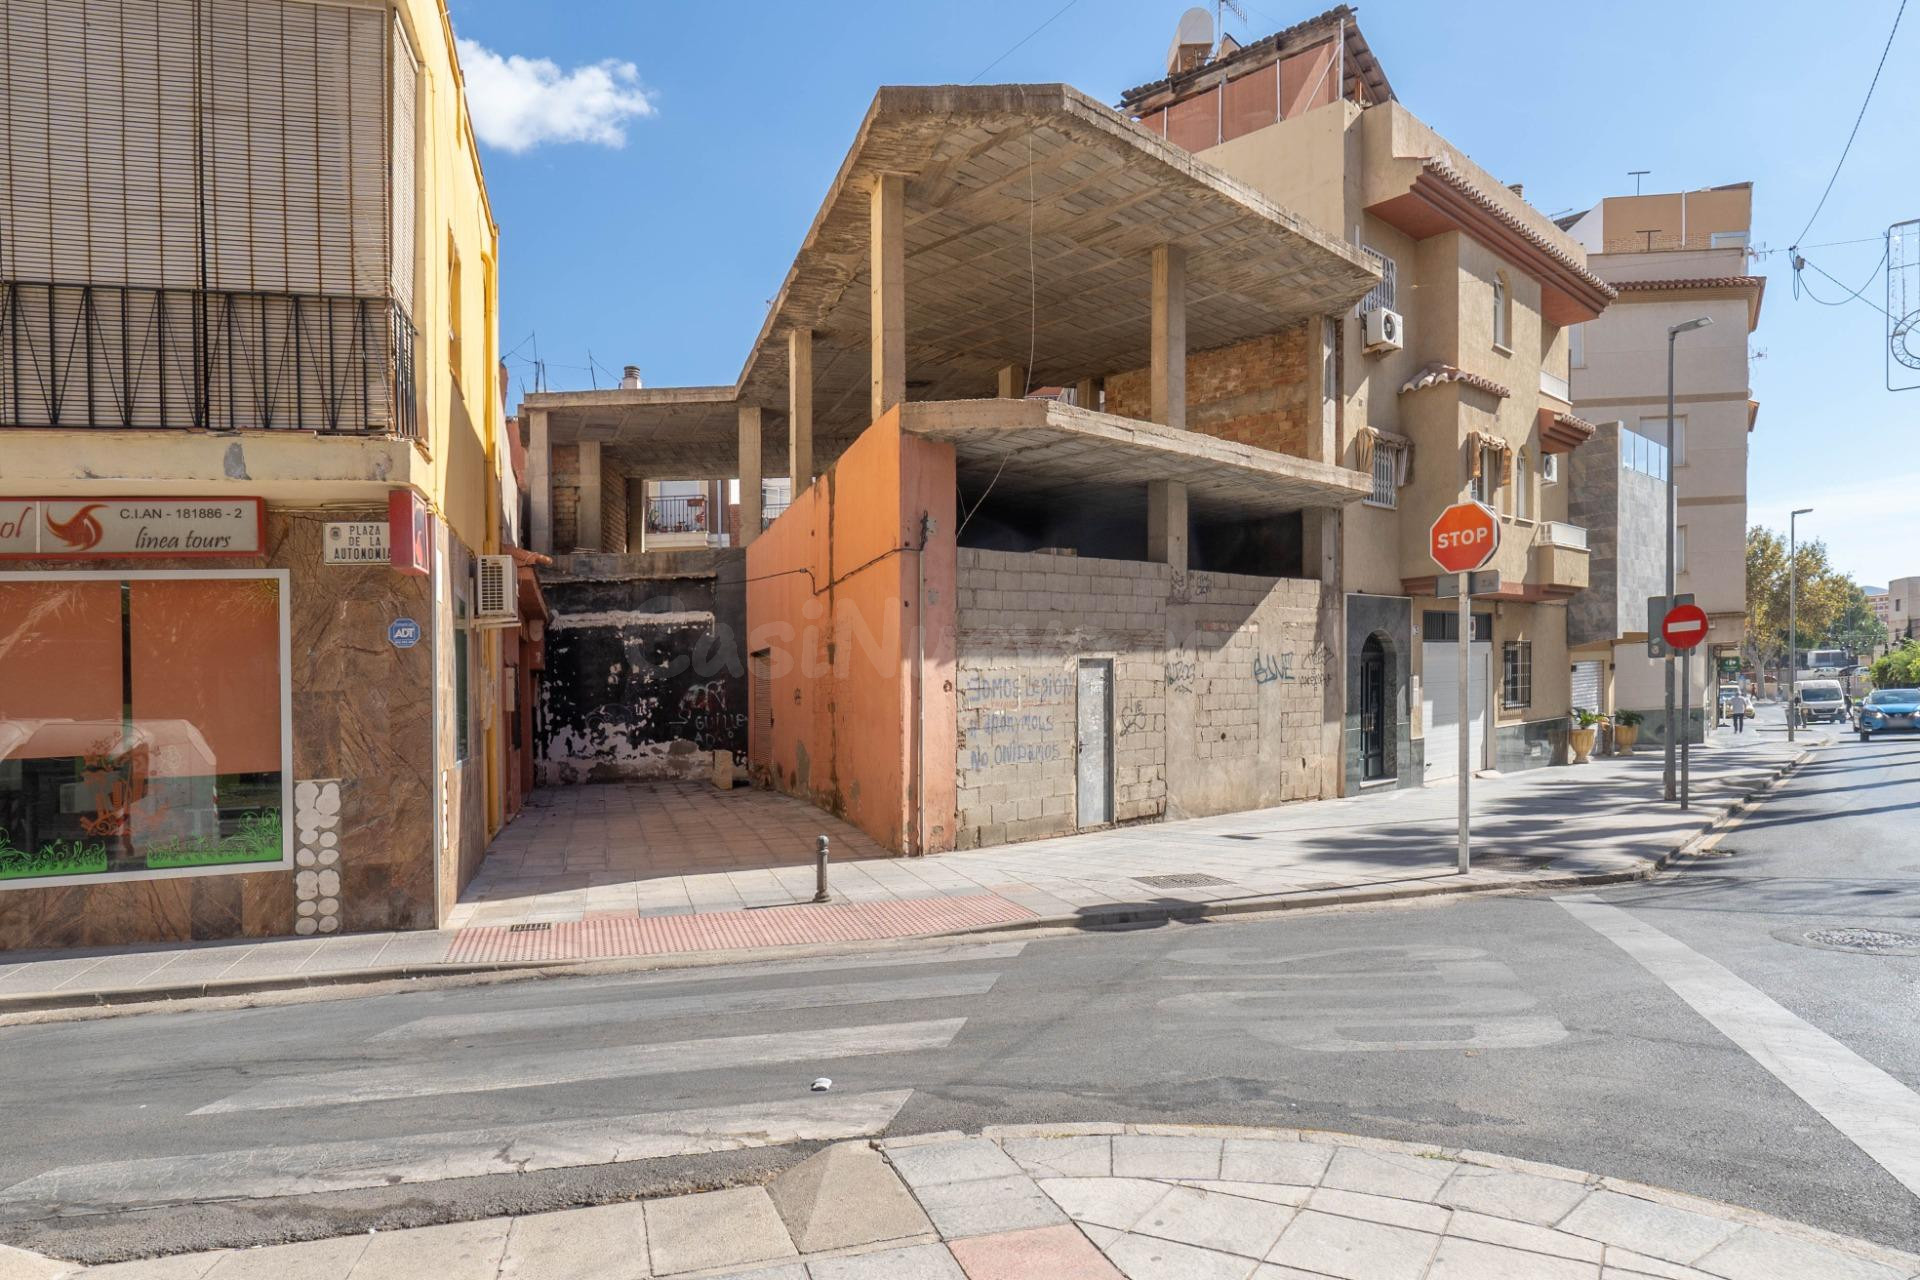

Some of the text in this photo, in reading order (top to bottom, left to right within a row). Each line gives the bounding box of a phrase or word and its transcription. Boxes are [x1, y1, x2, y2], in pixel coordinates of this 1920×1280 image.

[119, 508, 163, 520] C.I.AN
[175, 508, 223, 520] 181886
[234, 508, 243, 519] 2
[348, 525, 381, 536] PLAZA
[135, 525, 232, 549] linea tours
[348, 536, 382, 547] DE LA
[1437, 527, 1488, 549] STOP
[393, 627, 415, 638] ADT
